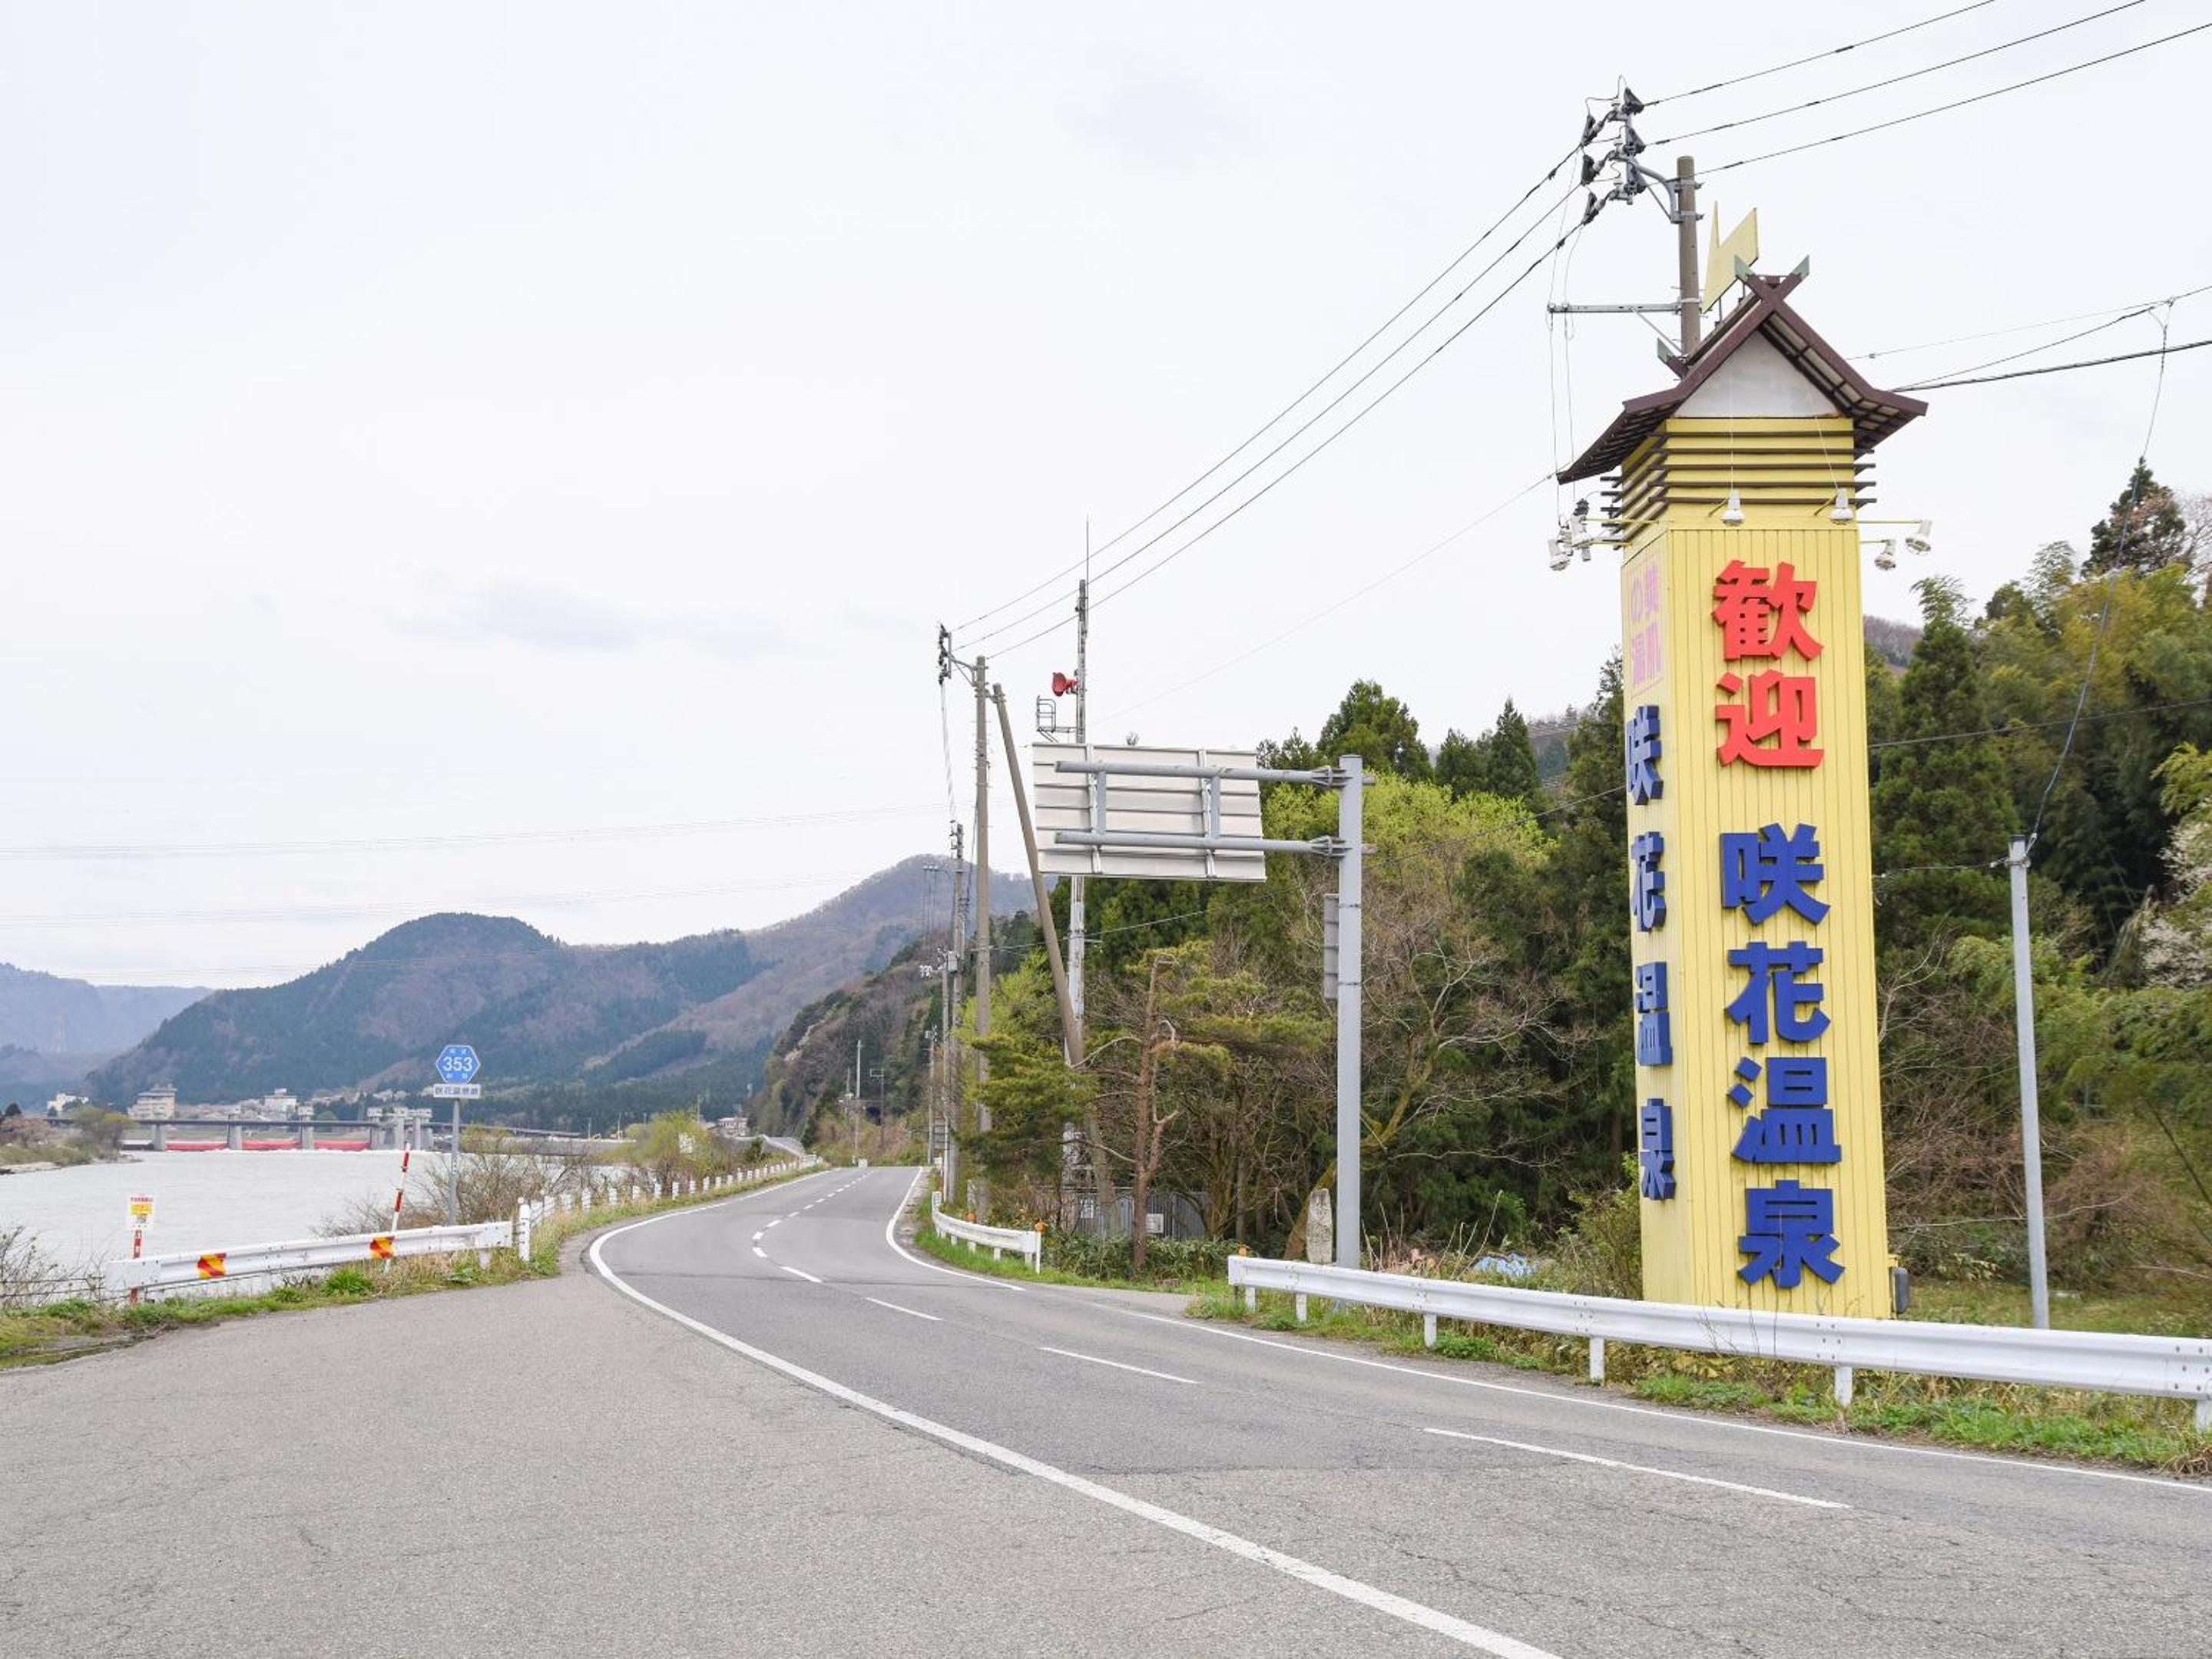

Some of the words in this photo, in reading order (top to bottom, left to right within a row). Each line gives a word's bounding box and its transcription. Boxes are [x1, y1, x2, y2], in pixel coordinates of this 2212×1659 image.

[1712, 560, 1826, 768] 歓迎
[442, 1055, 473, 1072] 353
[1626, 705, 1677, 1200] 咲花温泉
[1719, 823, 1846, 1289] 咲花温泉
